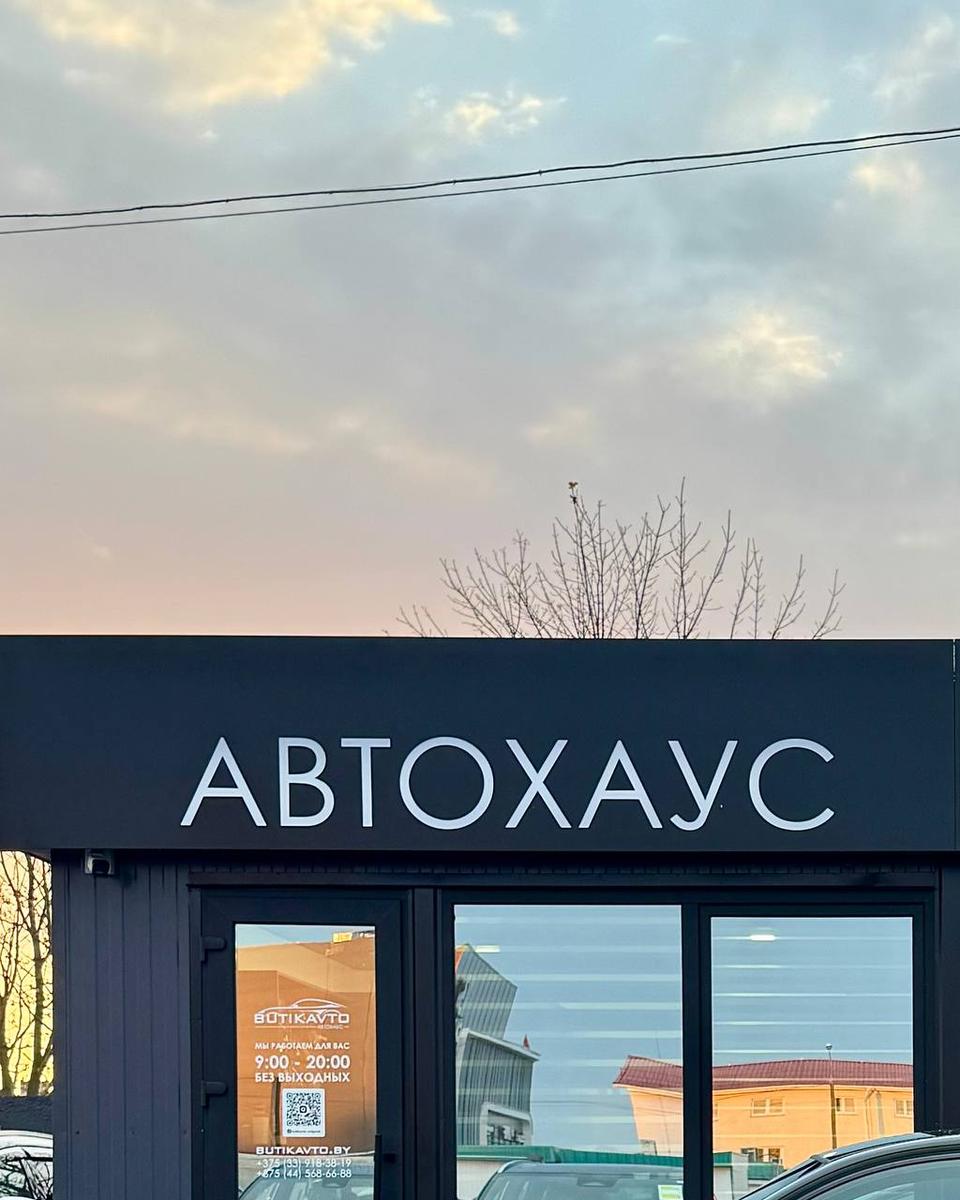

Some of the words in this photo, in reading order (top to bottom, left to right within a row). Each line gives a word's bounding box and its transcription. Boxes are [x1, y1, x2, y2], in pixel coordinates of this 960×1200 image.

[180, 736, 835, 832] АВТОХАУС
[254, 1013, 350, 1024] BUTIKAVTO
[254, 1042, 269, 1050] МЫ
[271, 1042, 313, 1050] РАБОТАЕМ
[314, 1042, 331, 1050] ДЛЯ
[333, 1042, 350, 1050] ВАС
[255, 1055, 289, 1069] 9:00
[306, 1055, 351, 1069] 20:00
[255, 1072, 275, 1083] БЕЗ
[278, 1072, 351, 1084] ВЫХОДНЫХ
[255, 1146, 352, 1155] BUTIKAVTO.BY
[304, 1168, 352, 1178] 568-66-88
